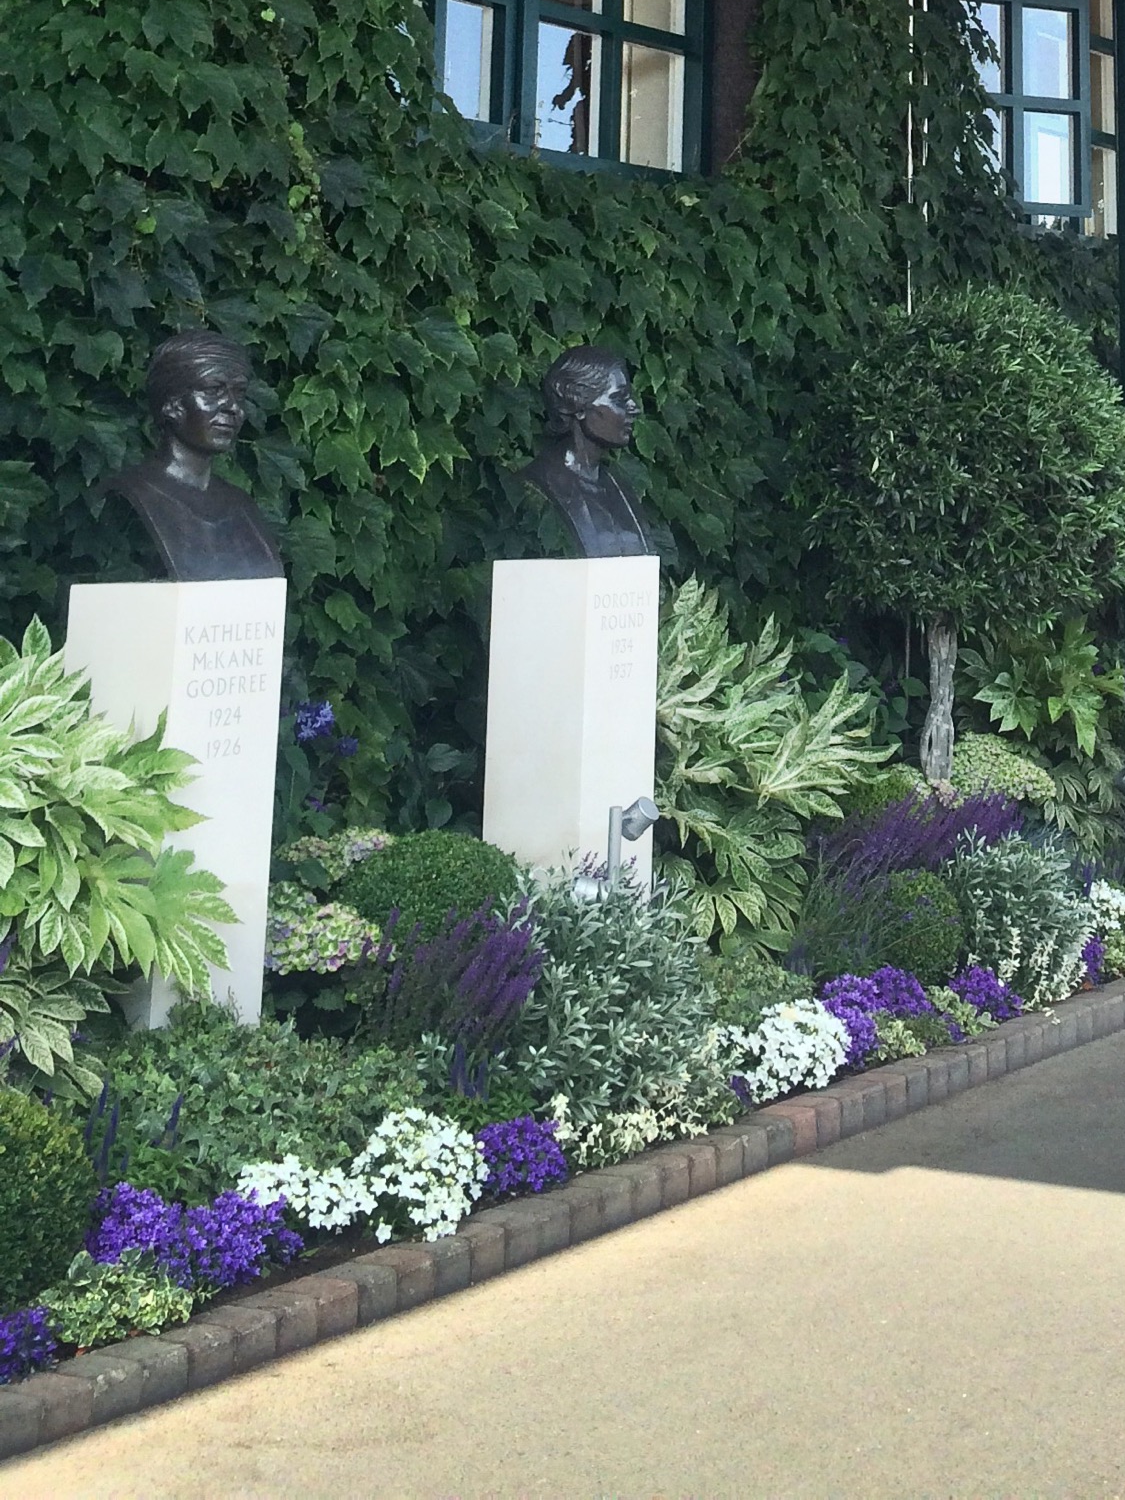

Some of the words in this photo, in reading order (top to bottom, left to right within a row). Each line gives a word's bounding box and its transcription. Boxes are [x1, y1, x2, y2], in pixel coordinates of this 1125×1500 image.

[593, 591, 652, 609] DOROTHY
[184, 621, 276, 645] KATHLEEN
[600, 613, 644, 631] ROUND
[611, 637, 634, 655] 1934
[192, 648, 264, 671] McKANE
[609, 663, 633, 680] 1937
[186, 674, 268, 699] GODFREE
[208, 706, 242, 728] 1924
[206, 737, 241, 759] 1926
